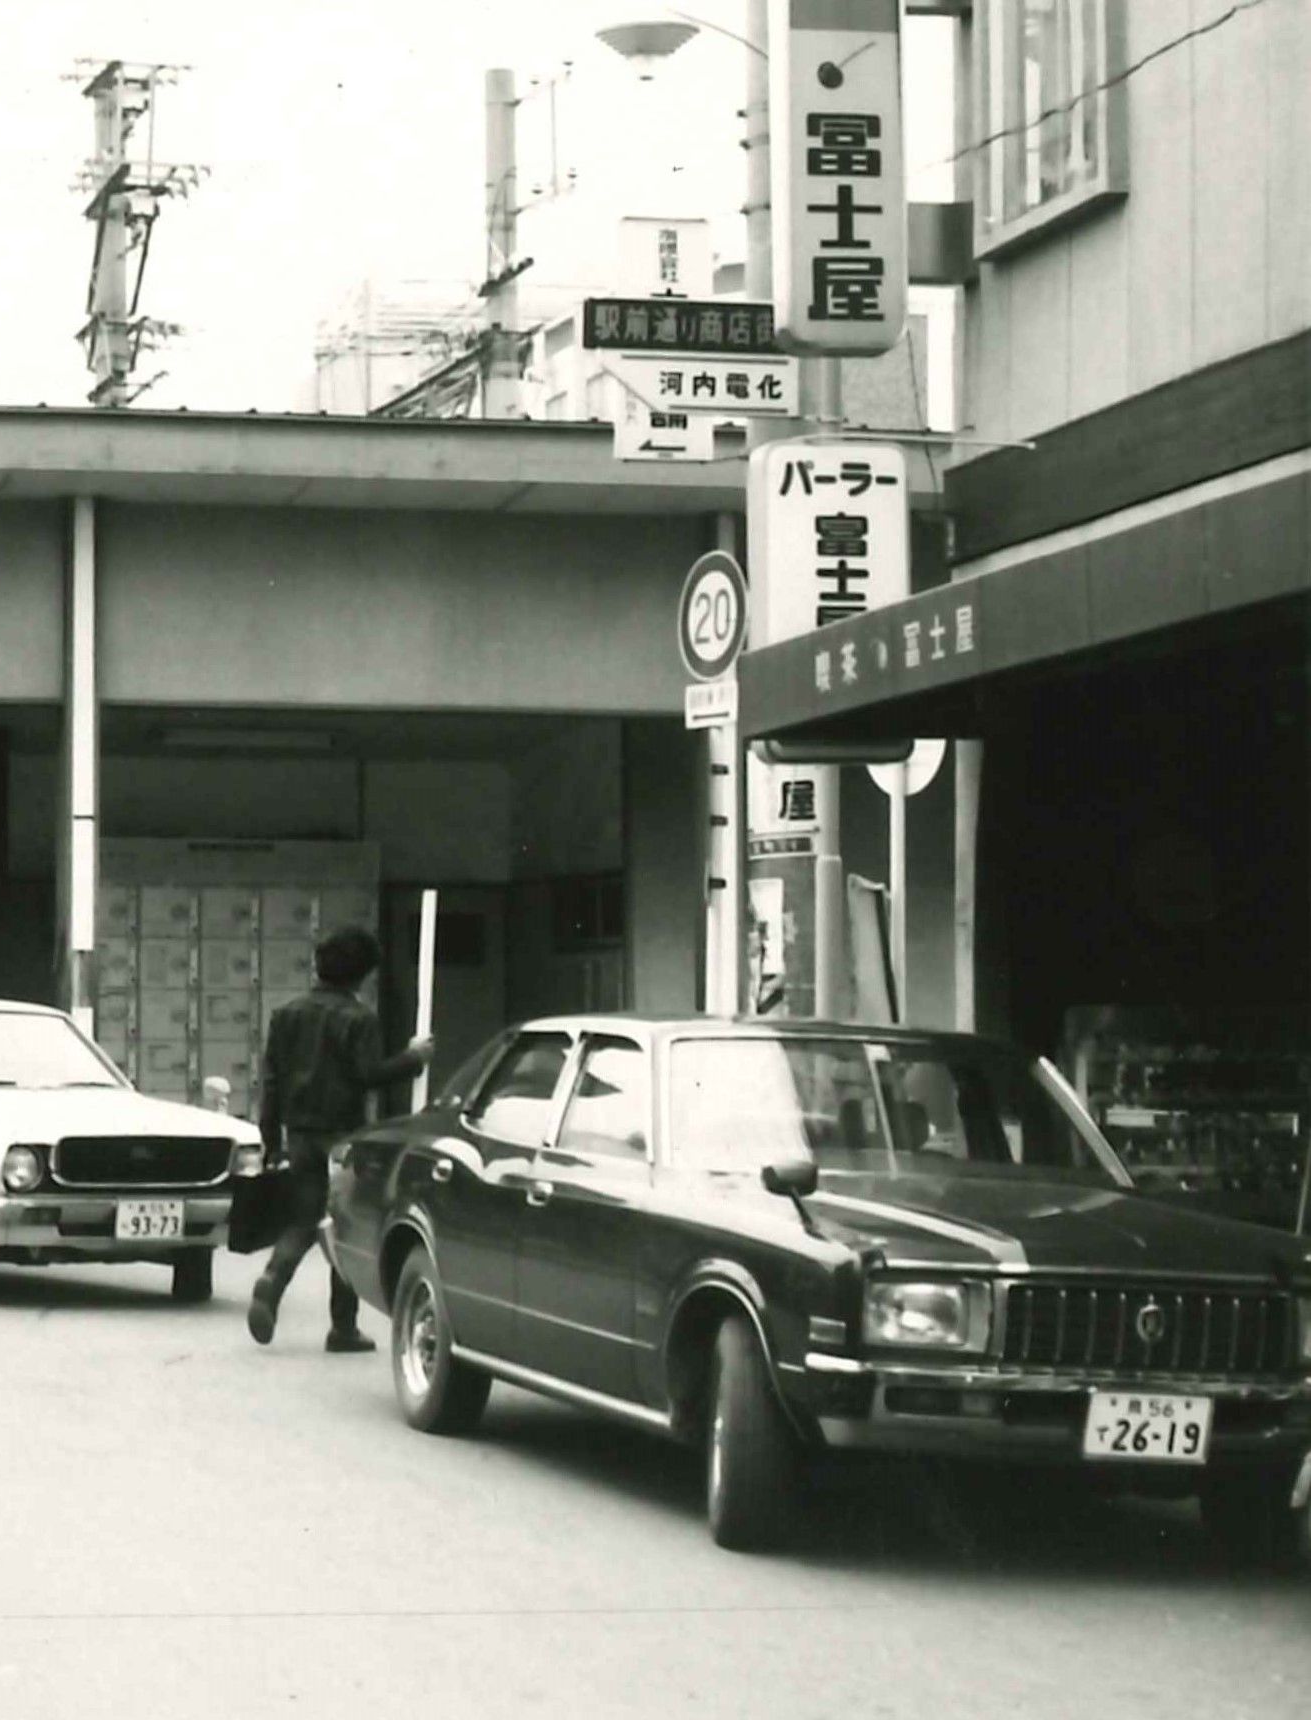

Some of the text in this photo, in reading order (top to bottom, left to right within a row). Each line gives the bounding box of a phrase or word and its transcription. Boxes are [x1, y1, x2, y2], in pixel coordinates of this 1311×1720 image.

[806, 112, 884, 321] 富士屋
[659, 371, 783, 400] 河内電化
[780, 461, 897, 496] パーラー
[695, 590, 730, 645] 20
[903, 605, 975, 668] 富士屋
[779, 780, 816, 821] 屋
[131, 1216, 179, 1236] 93-73
[1111, 1418, 1201, 1455] 26-19
